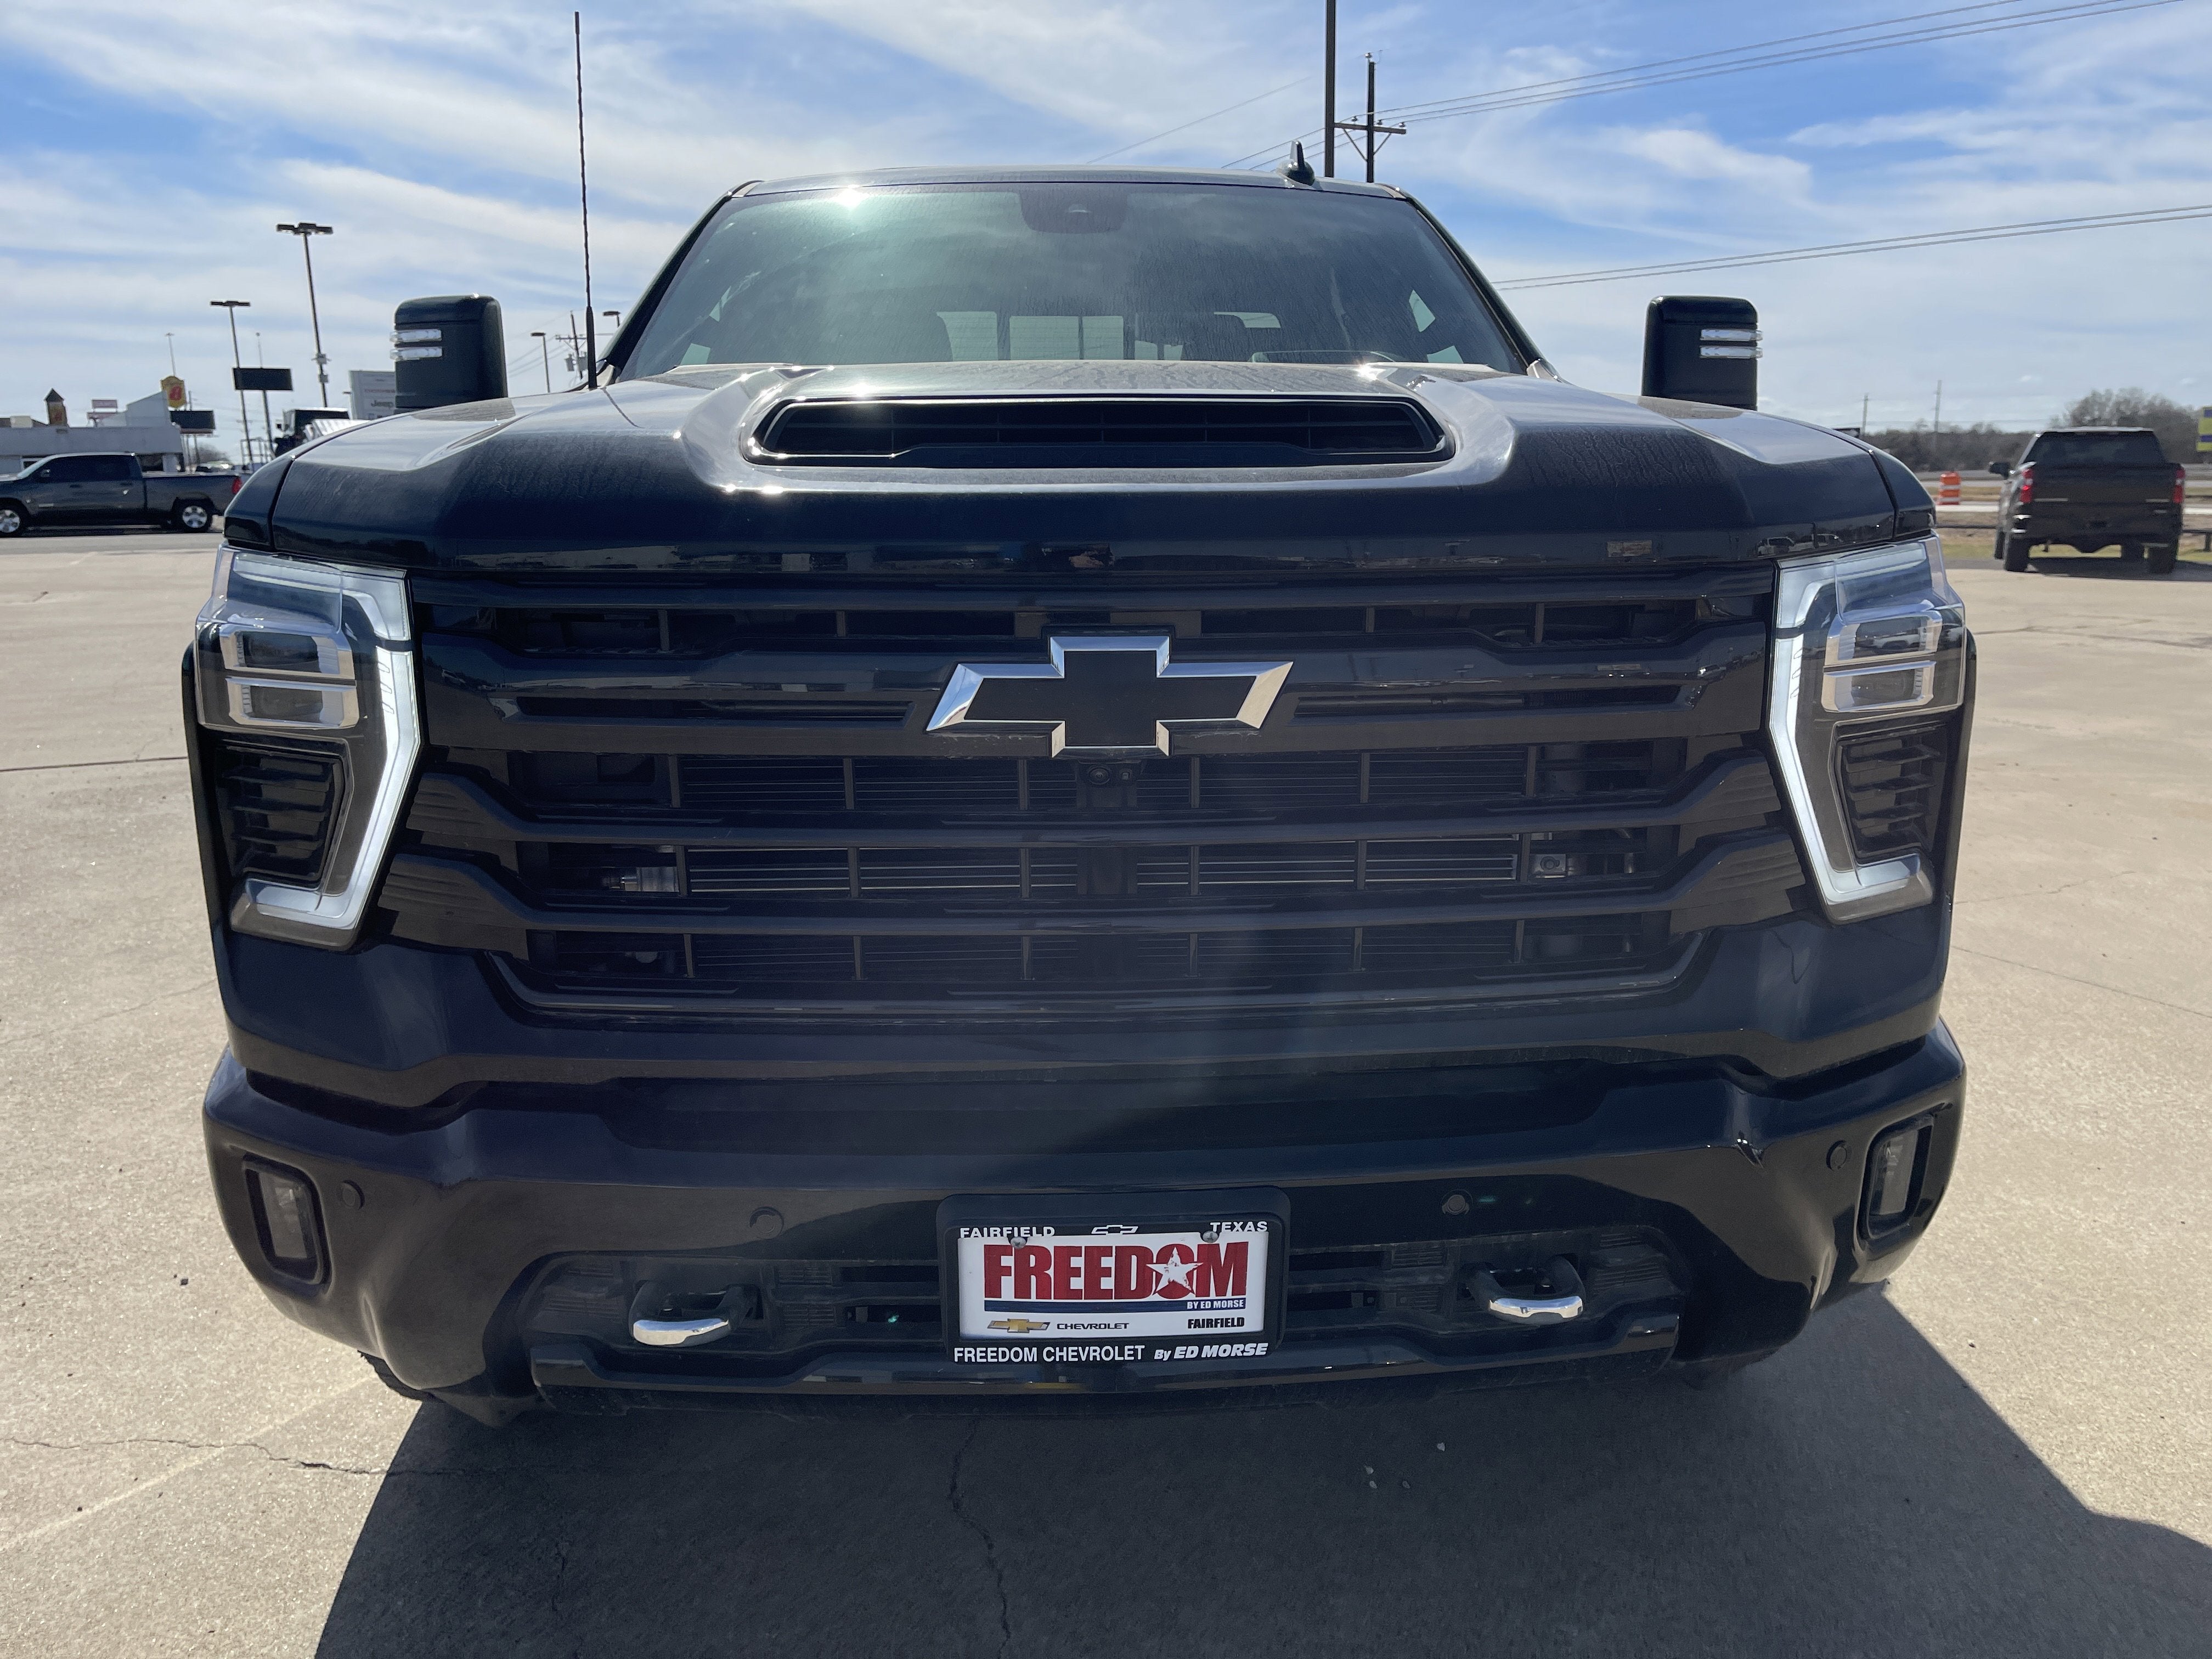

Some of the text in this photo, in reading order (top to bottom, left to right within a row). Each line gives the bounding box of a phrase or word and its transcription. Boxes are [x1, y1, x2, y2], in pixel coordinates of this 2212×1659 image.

[960, 1226, 1055, 1238] FAIRFIELD
[1210, 1221, 1267, 1232] TEXAS
[984, 1242, 1249, 1300] FREEDOM
[1187, 1299, 1244, 1310] BY ED MORSE
[1187, 1317, 1245, 1329] FAIRFIELD
[953, 1342, 1269, 1362] FREEDOM CHEVROLET By ED MORSE
